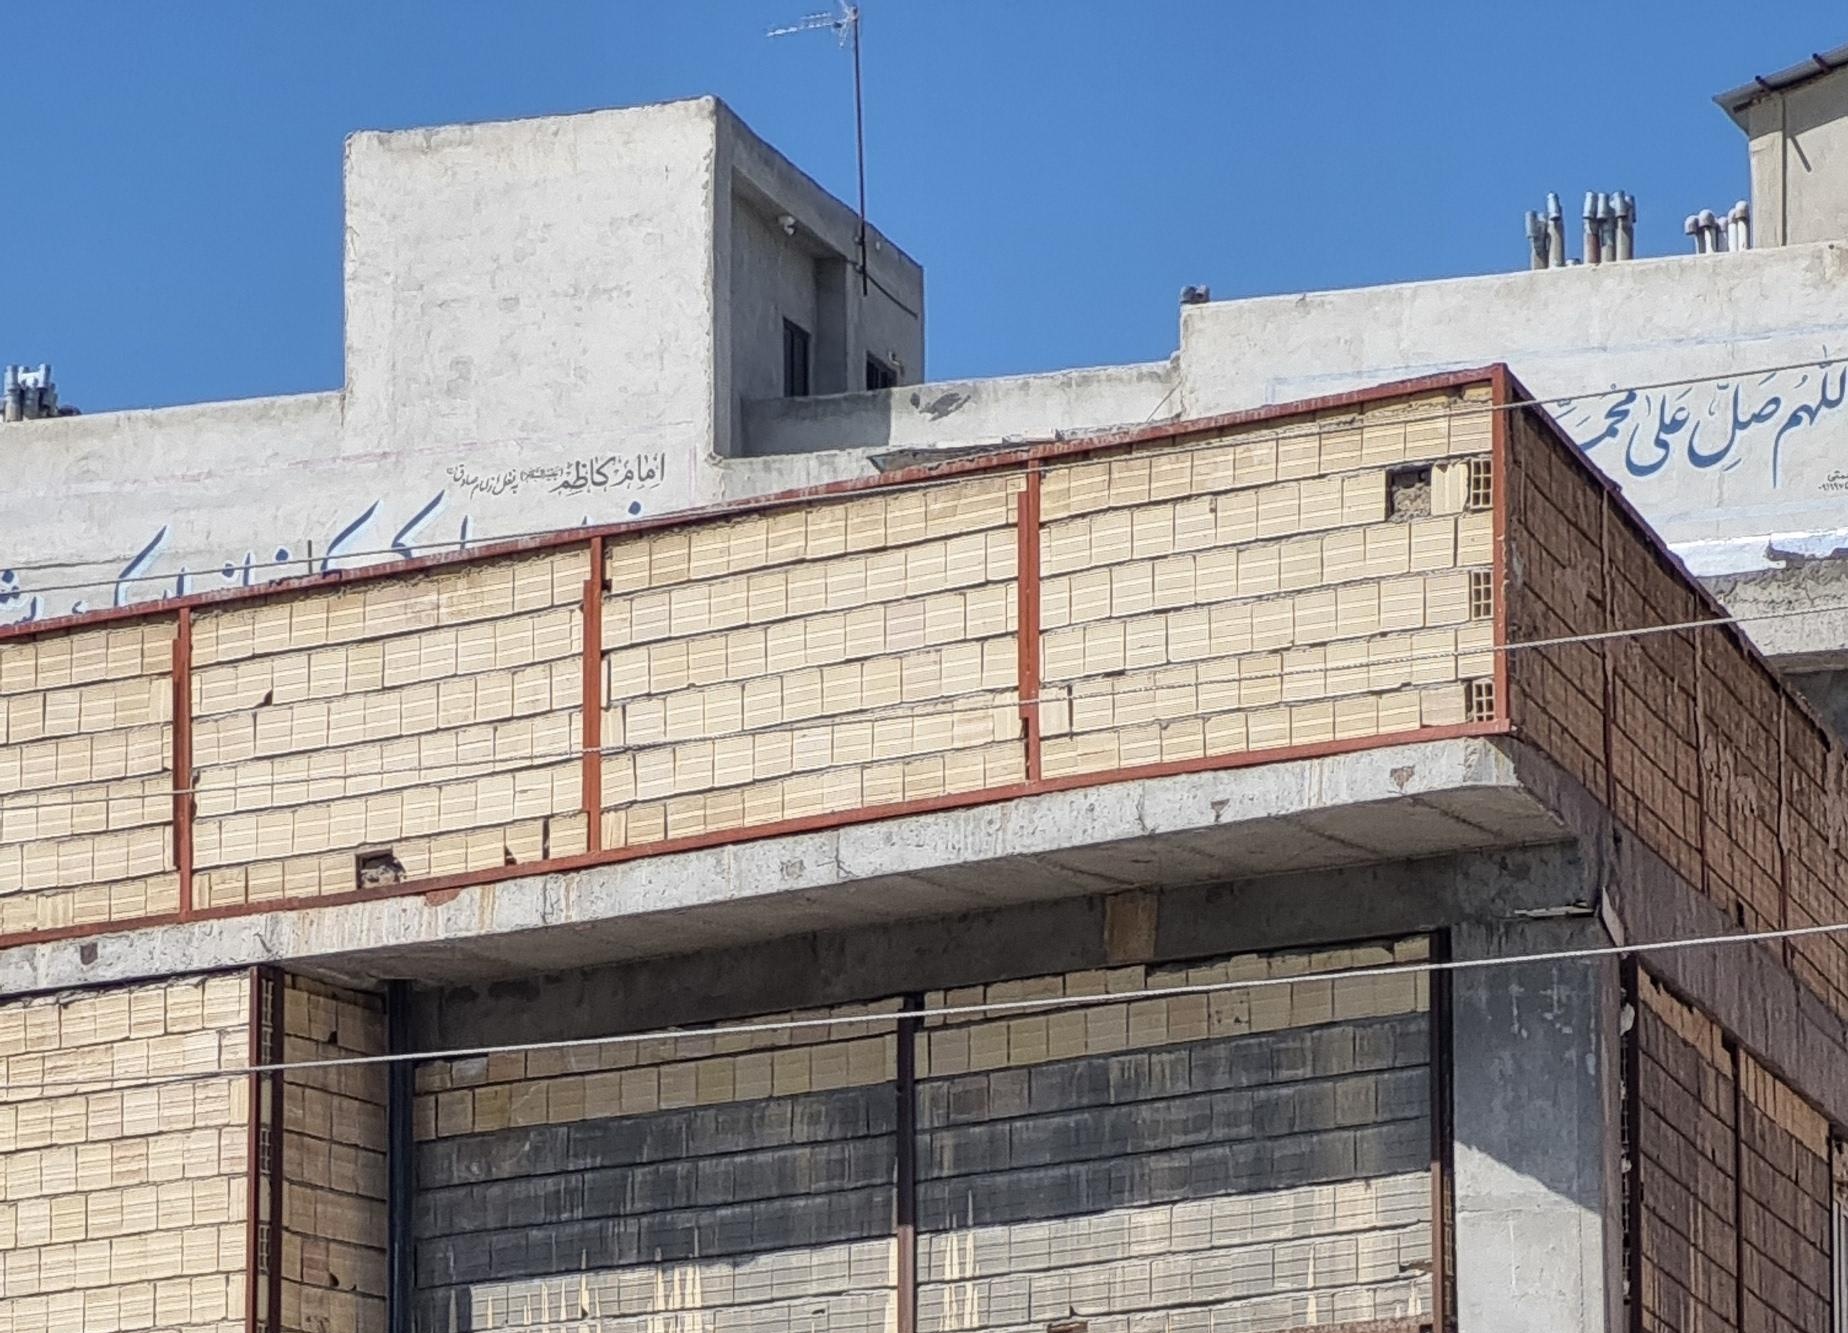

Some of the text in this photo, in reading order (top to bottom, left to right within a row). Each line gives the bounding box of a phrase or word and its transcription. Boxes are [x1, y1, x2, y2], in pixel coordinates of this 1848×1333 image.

[1556, 384, 1639, 452] محم
[1773, 344, 1848, 489] للهم
[549, 456, 616, 496] کاظم
